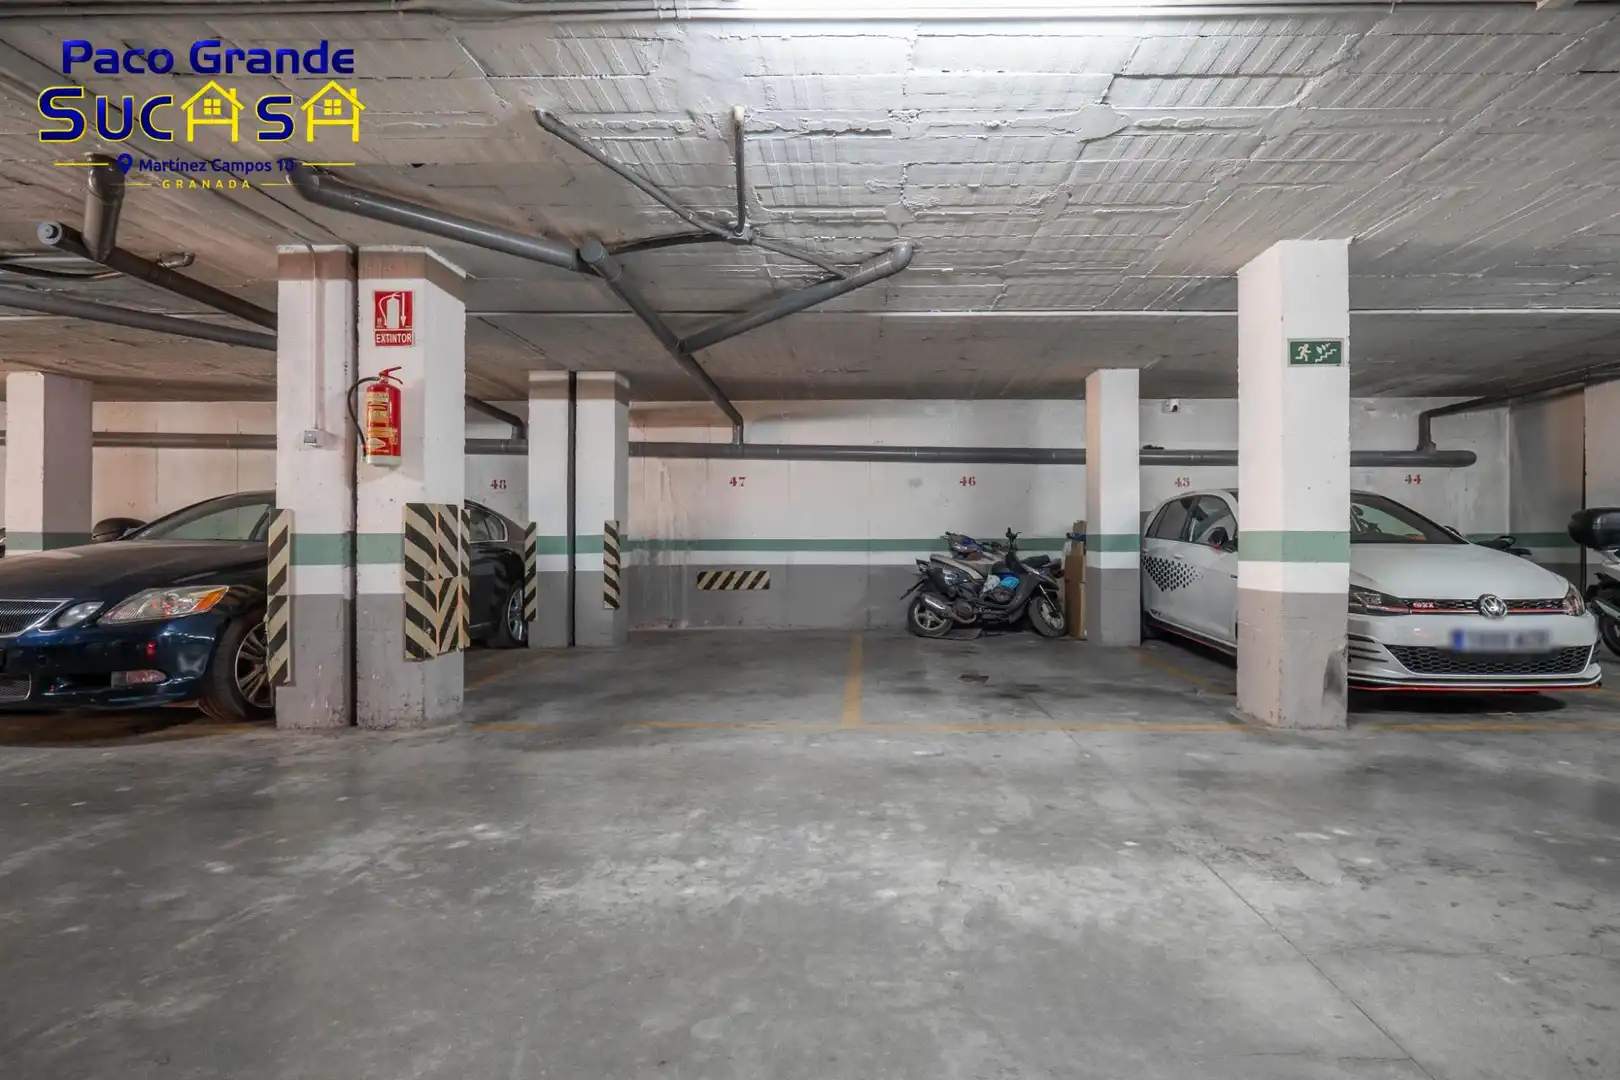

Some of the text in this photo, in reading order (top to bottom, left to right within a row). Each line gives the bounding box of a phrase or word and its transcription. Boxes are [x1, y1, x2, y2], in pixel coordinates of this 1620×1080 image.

[376, 333, 412, 344] EXTINTOR
[729, 476, 746, 487] 47
[959, 475, 977, 487] 46
[1405, 474, 1422, 485] 44
